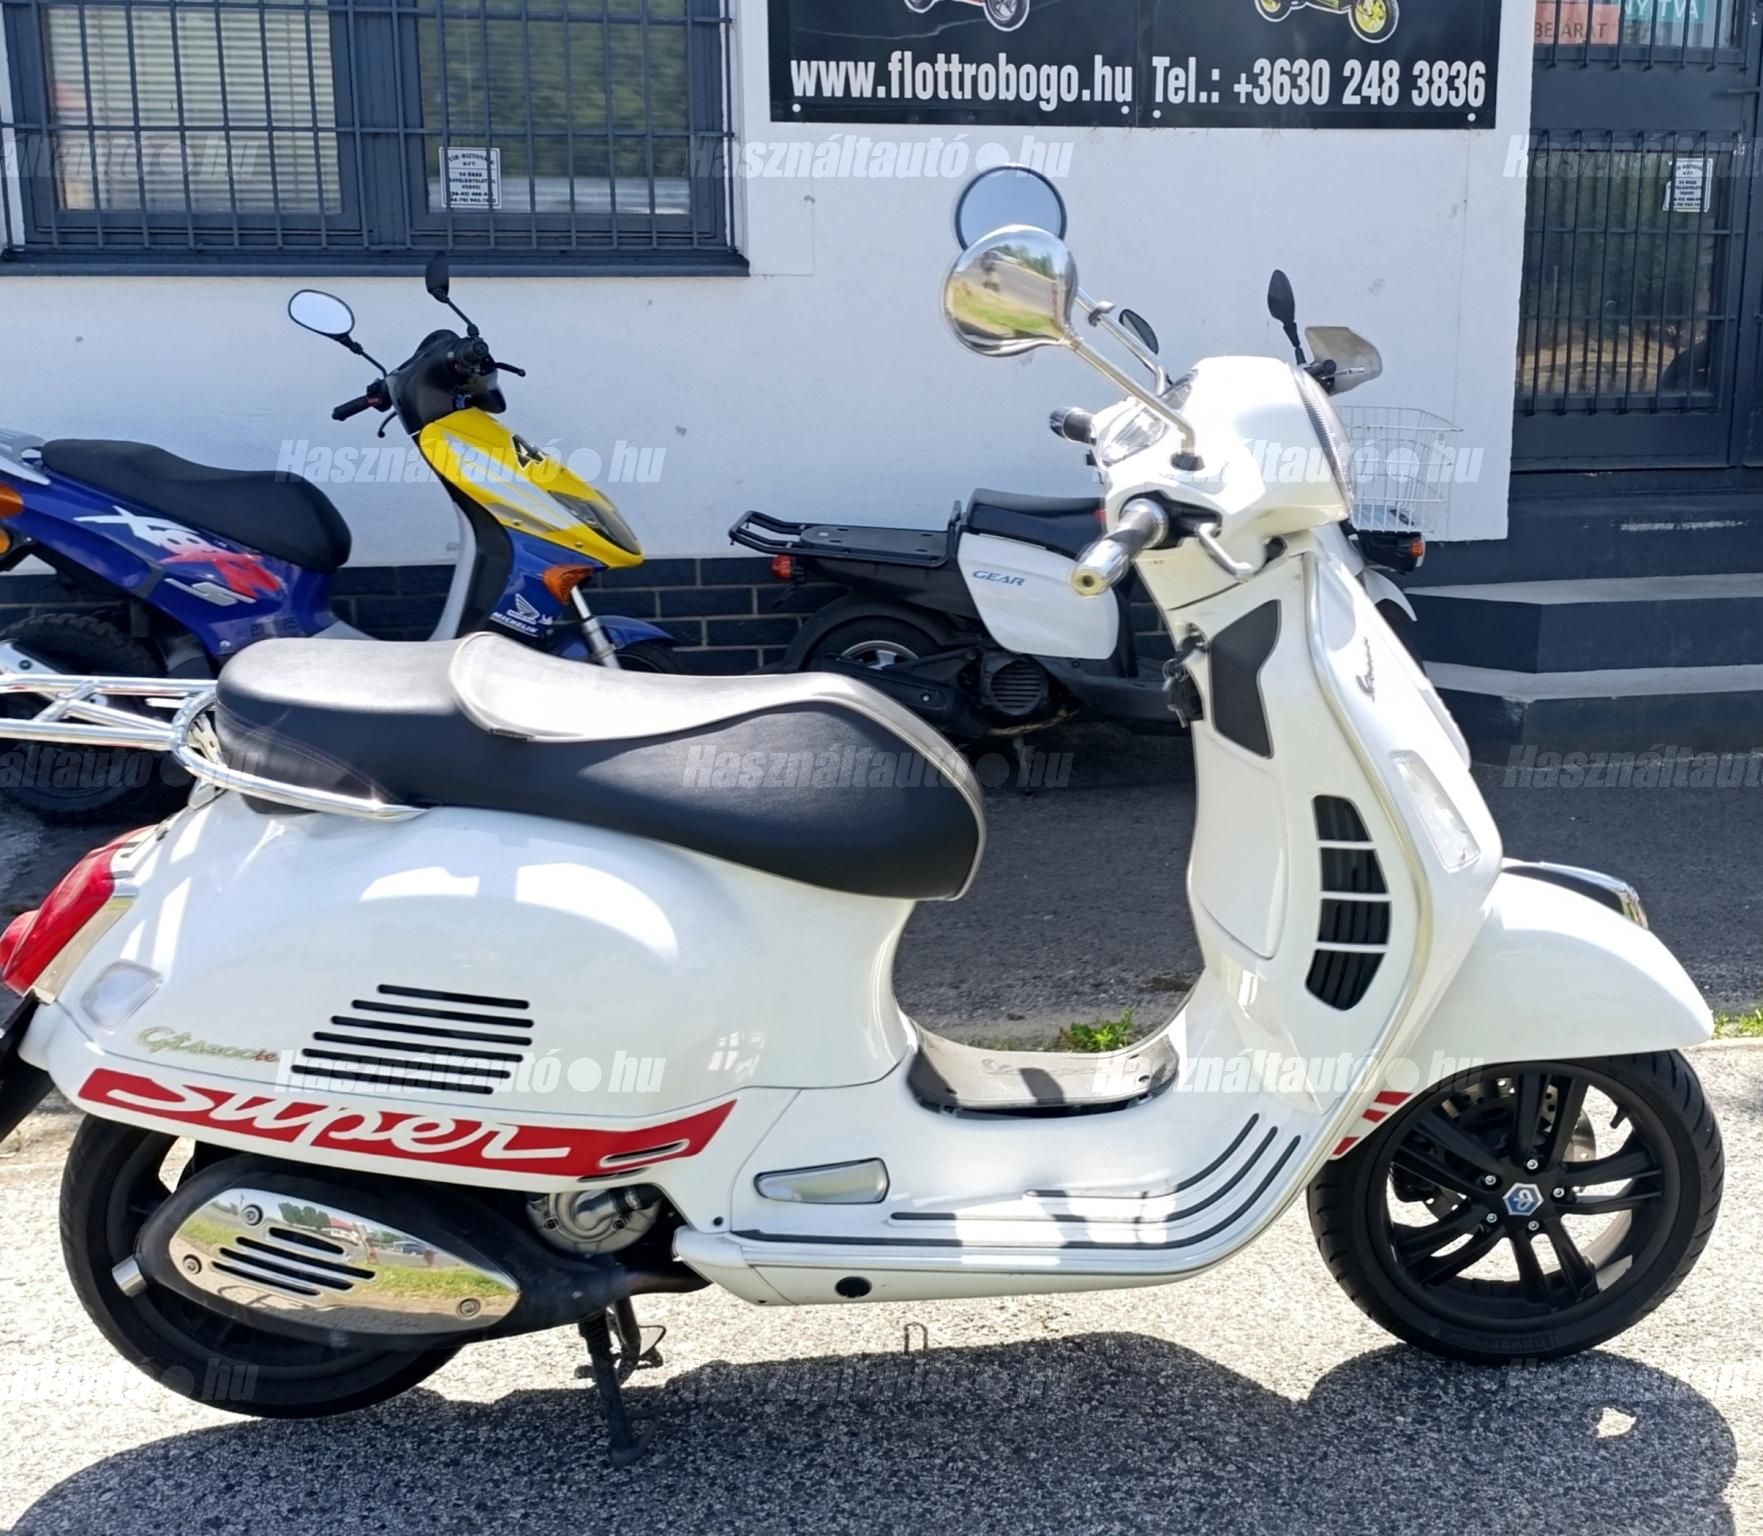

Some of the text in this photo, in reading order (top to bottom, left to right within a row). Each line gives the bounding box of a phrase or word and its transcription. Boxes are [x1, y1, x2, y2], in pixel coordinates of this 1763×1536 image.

[1624, 0, 1699, 19] NYTVA
[1534, 19, 1608, 39] BEÁRT
[790, 51, 1487, 112] www.flottrobogo.hu Tel.: +3630 248 3836
[972, 569, 1026, 587] GEAR
